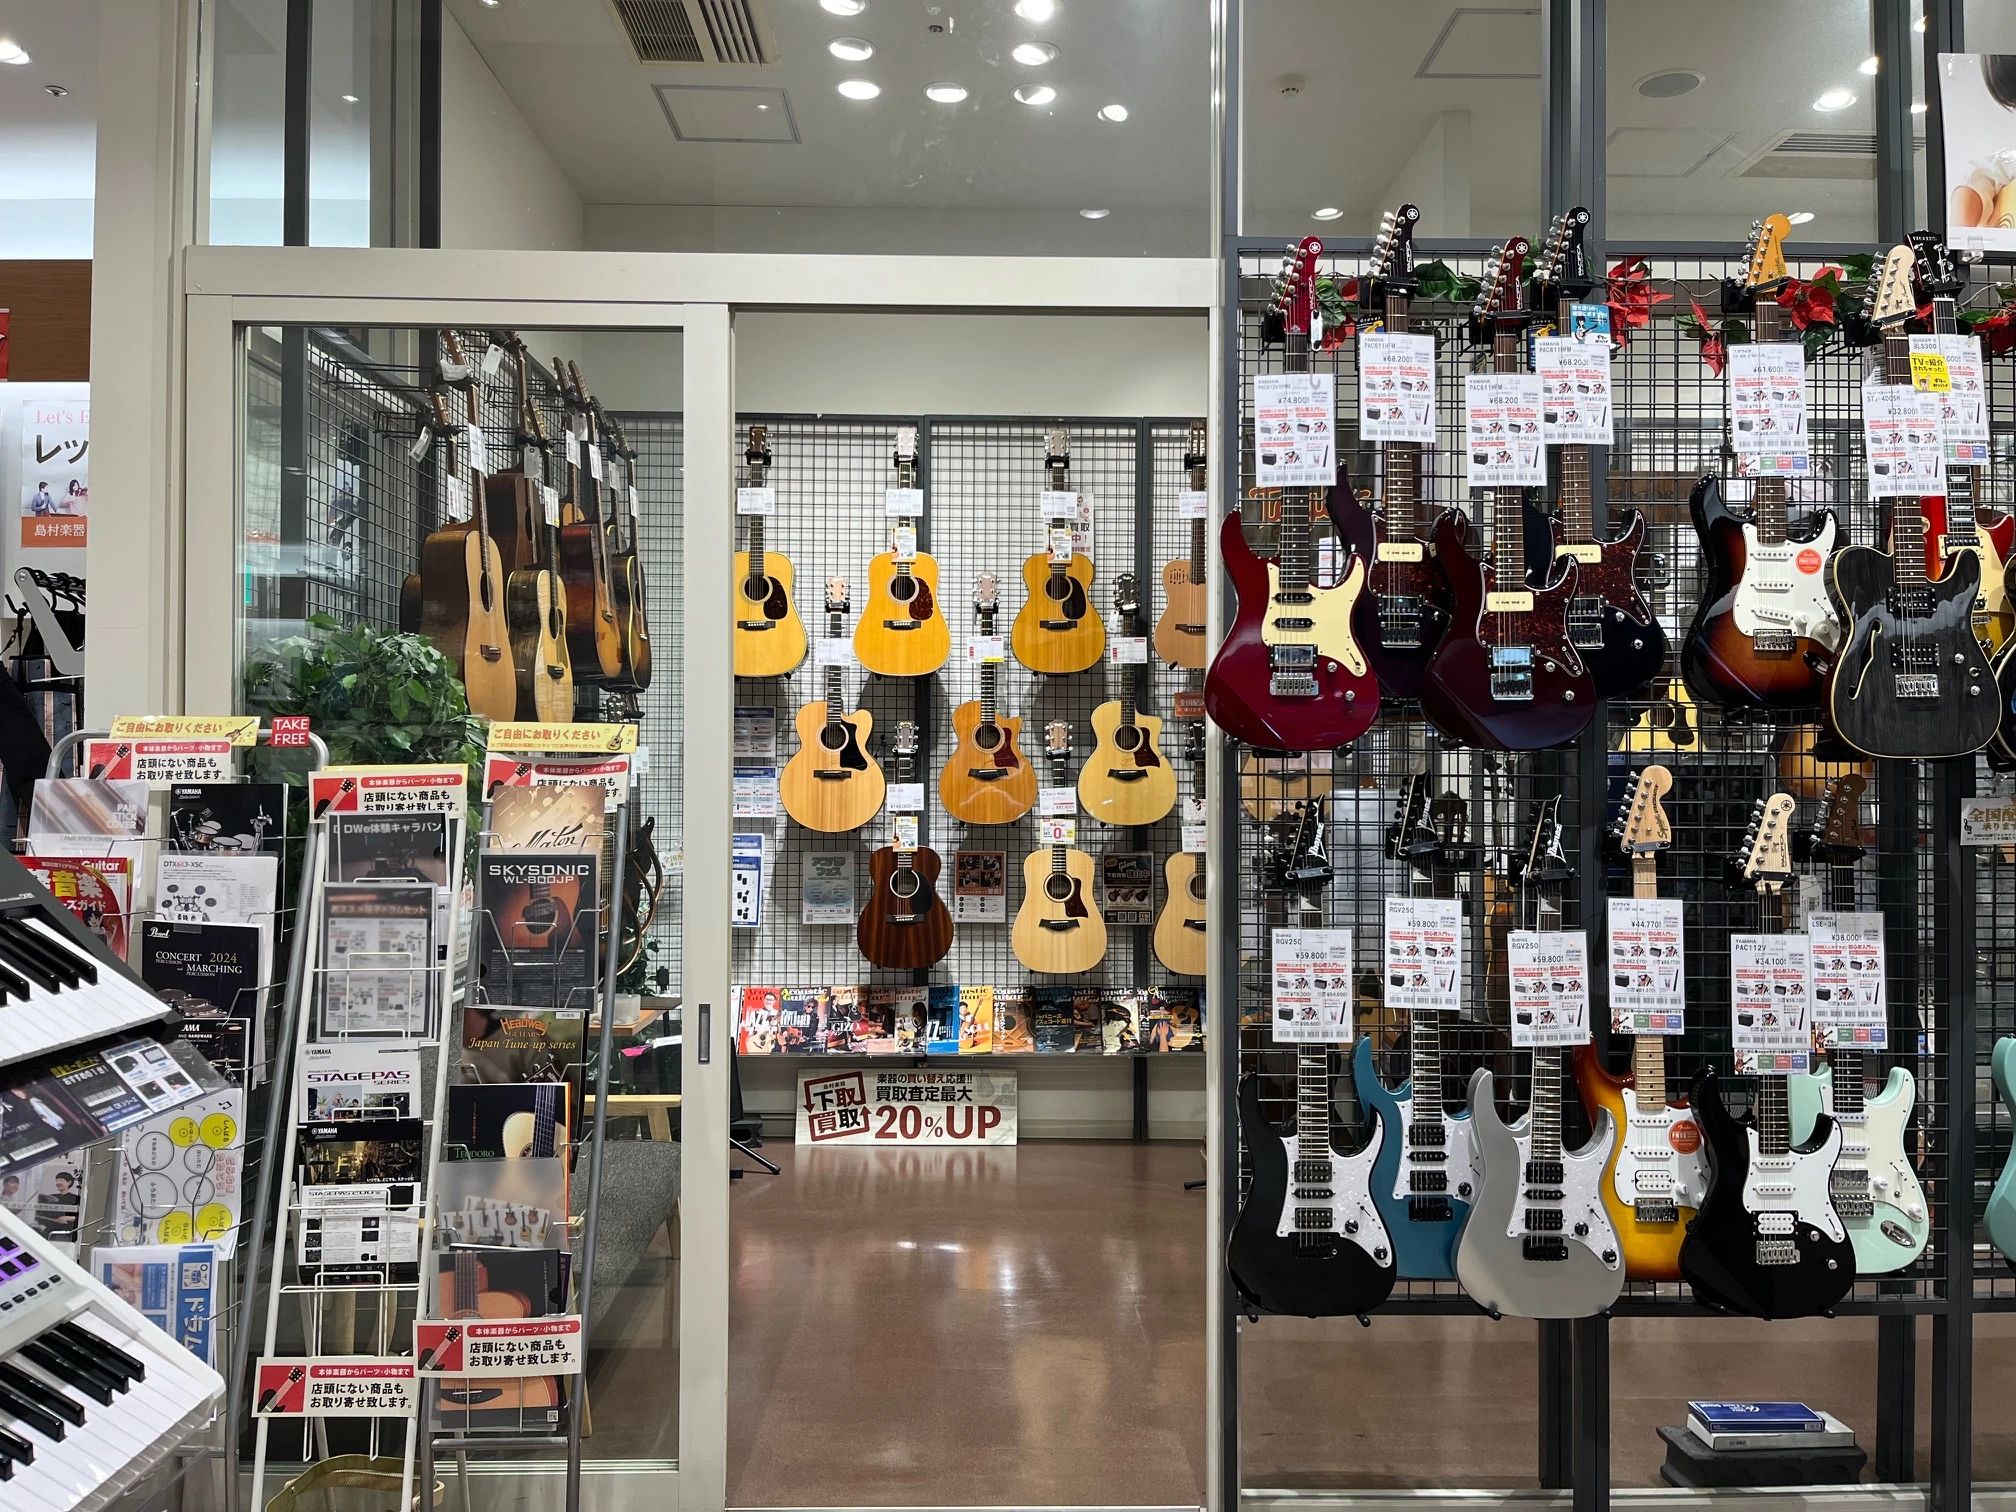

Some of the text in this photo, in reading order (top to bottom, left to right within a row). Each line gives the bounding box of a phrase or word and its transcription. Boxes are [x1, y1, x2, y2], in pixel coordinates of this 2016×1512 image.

[1405, 240, 1413, 273] PACIFICA
[1576, 243, 1584, 277] PACIFICA
[1308, 275, 1316, 310] PACIFICA
[1514, 275, 1523, 311] PACIFICA
[36, 409, 73, 424] Let's
[36, 435, 89, 464] レッ
[34, 524, 85, 537] 島村楽器
[116, 721, 222, 734] ご自由にお取りください
[274, 719, 309, 731] TAKE
[274, 733, 307, 745] FREE
[494, 729, 601, 740] ご自由にお取りください
[137, 758, 217, 769] 店頭にない商品も
[136, 770, 226, 781] お取り寄せ致します。
[364, 790, 450, 803] 店頭にない商品も
[1416, 797, 1431, 829] Ibanez
[106, 820, 137, 829] COVER
[344, 822, 442, 834] DWe体験キャラバン
[1310, 823, 1325, 856] Ibanez
[1547, 824, 1562, 857] Ibanez
[81, 861, 119, 871] Guitar
[489, 864, 590, 876] SKYSONIC
[503, 875, 575, 885] WL-800JP
[148, 926, 170, 939] Pearl
[156, 951, 238, 963] CONCERT 2024
[186, 963, 243, 974] MARCHING
[181, 1024, 200, 1032] AMA
[500, 1014, 549, 1036] Headway
[468, 1037, 577, 1052] Japan Tune-up series
[307, 1070, 411, 1083] STAGEPAS
[876, 1073, 973, 1084] 楽器の買い替え応援!!
[813, 1087, 857, 1112] 下取
[876, 1085, 973, 1102] 買取査定最大
[817, 1107, 862, 1134] 買取
[874, 1104, 1002, 1140] 20%UP
[475, 1323, 571, 1336] 本体楽器からパーツ・小物まで
[469, 1339, 566, 1354] 店頭にない商品も
[469, 1351, 576, 1367] お取り寄せ致します。
[318, 1368, 411, 1376] 本体楽器からパーツ・小物まで
[311, 1382, 404, 1395] 店頭にない商品も
[310, 1396, 413, 1409] お取り寄せ致します。
